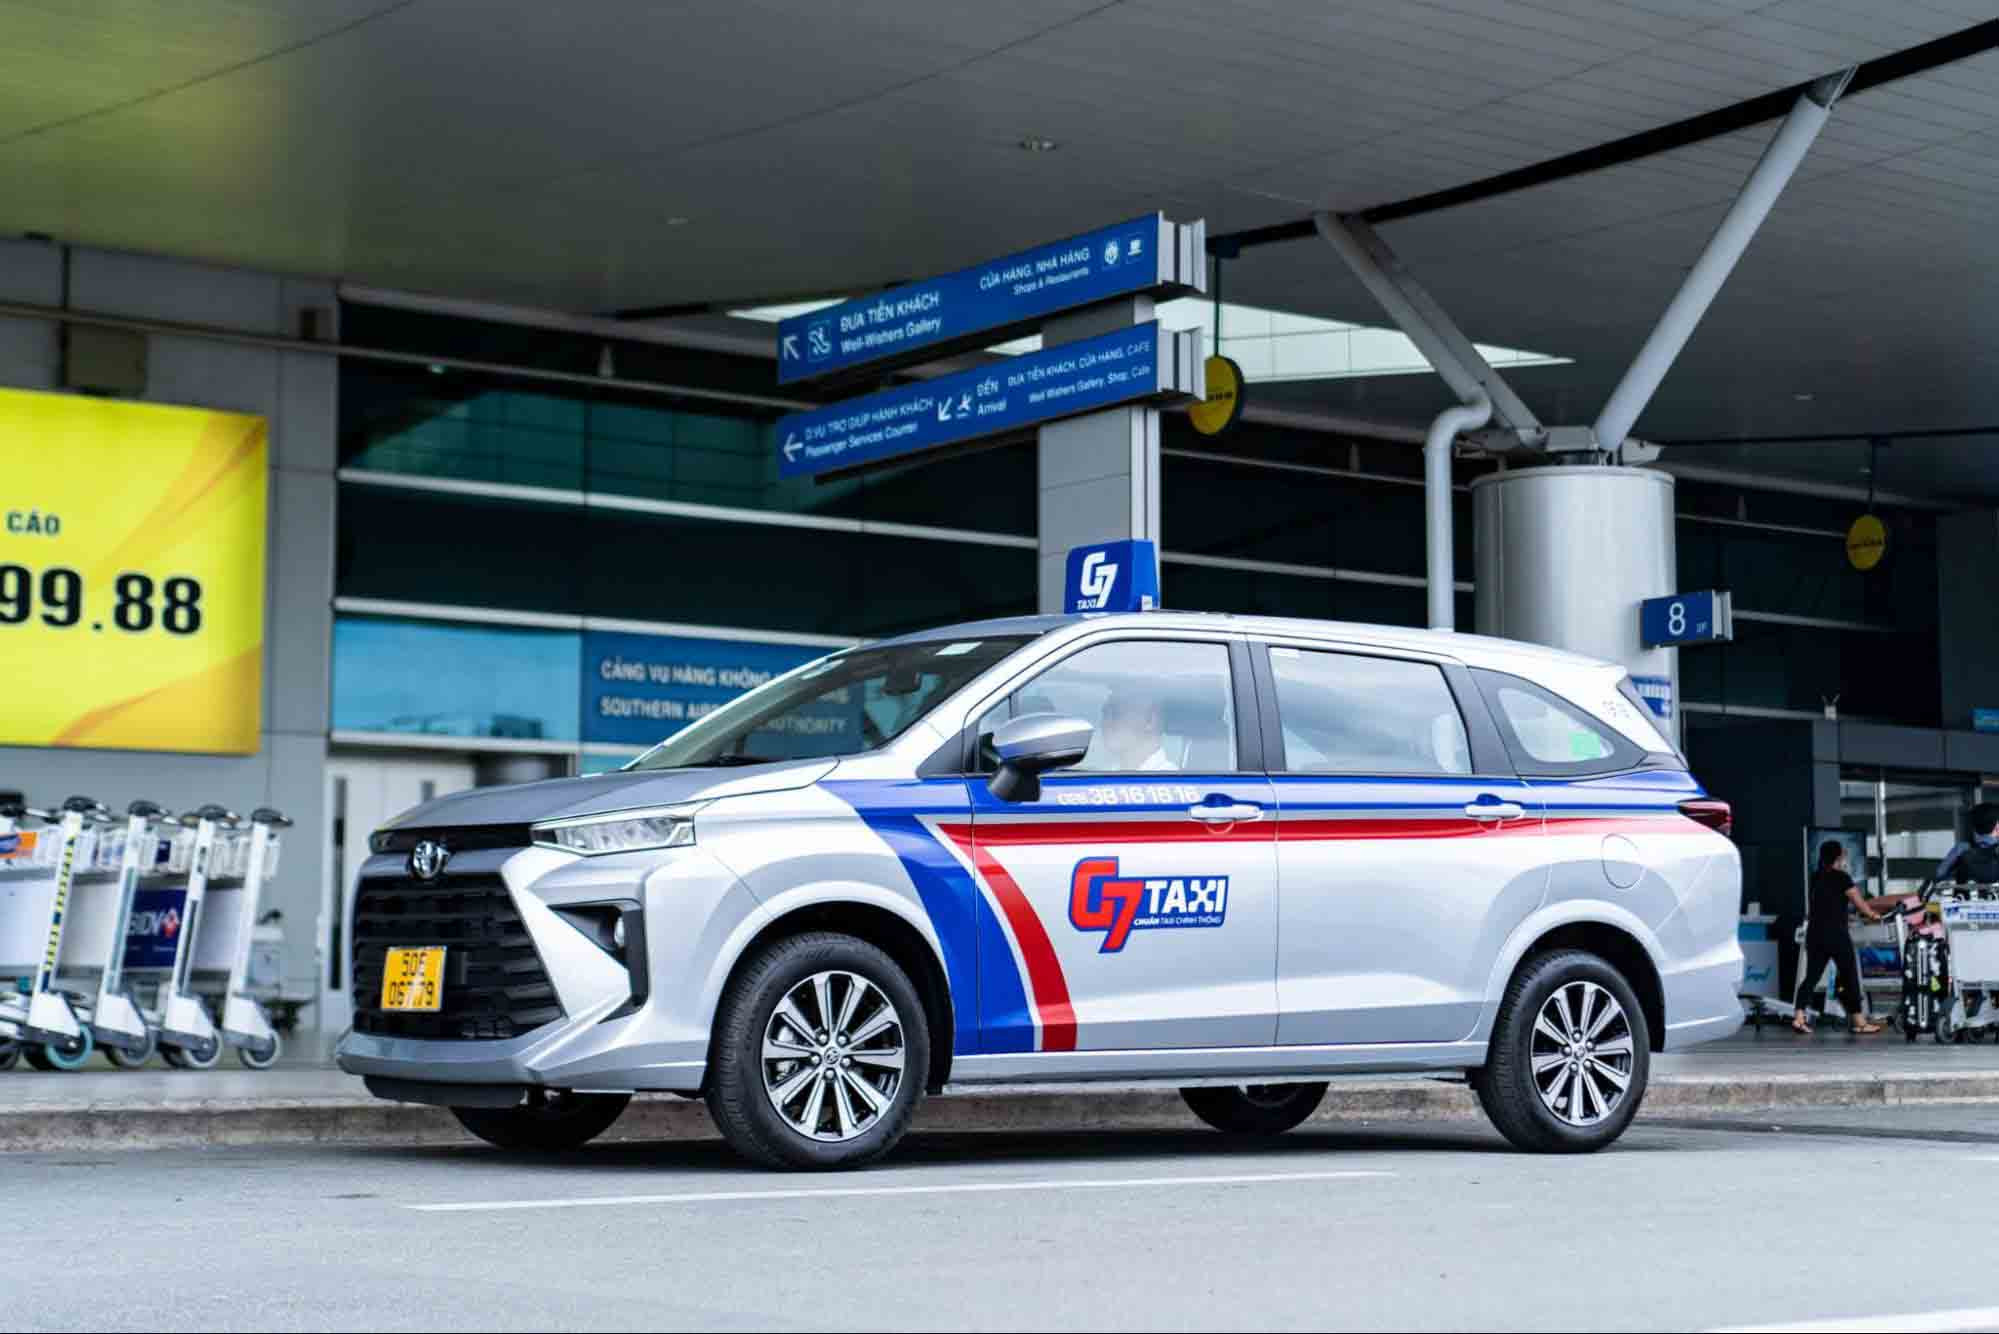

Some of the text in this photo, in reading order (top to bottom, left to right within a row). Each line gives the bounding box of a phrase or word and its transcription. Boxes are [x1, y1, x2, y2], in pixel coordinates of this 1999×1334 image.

[896, 290, 940, 317] KHÁCH
[906, 317, 942, 337] Gallery
[977, 398, 1007, 416] Arrival
[848, 431, 883, 449] Services
[885, 421, 918, 440] Counter
[7, 508, 60, 534] CÁO
[1077, 599, 1099, 610] TAXI
[1668, 602, 1686, 636] 8
[600, 695, 684, 719] SOUTHERN
[1071, 859, 1226, 951] G7 TAXI
